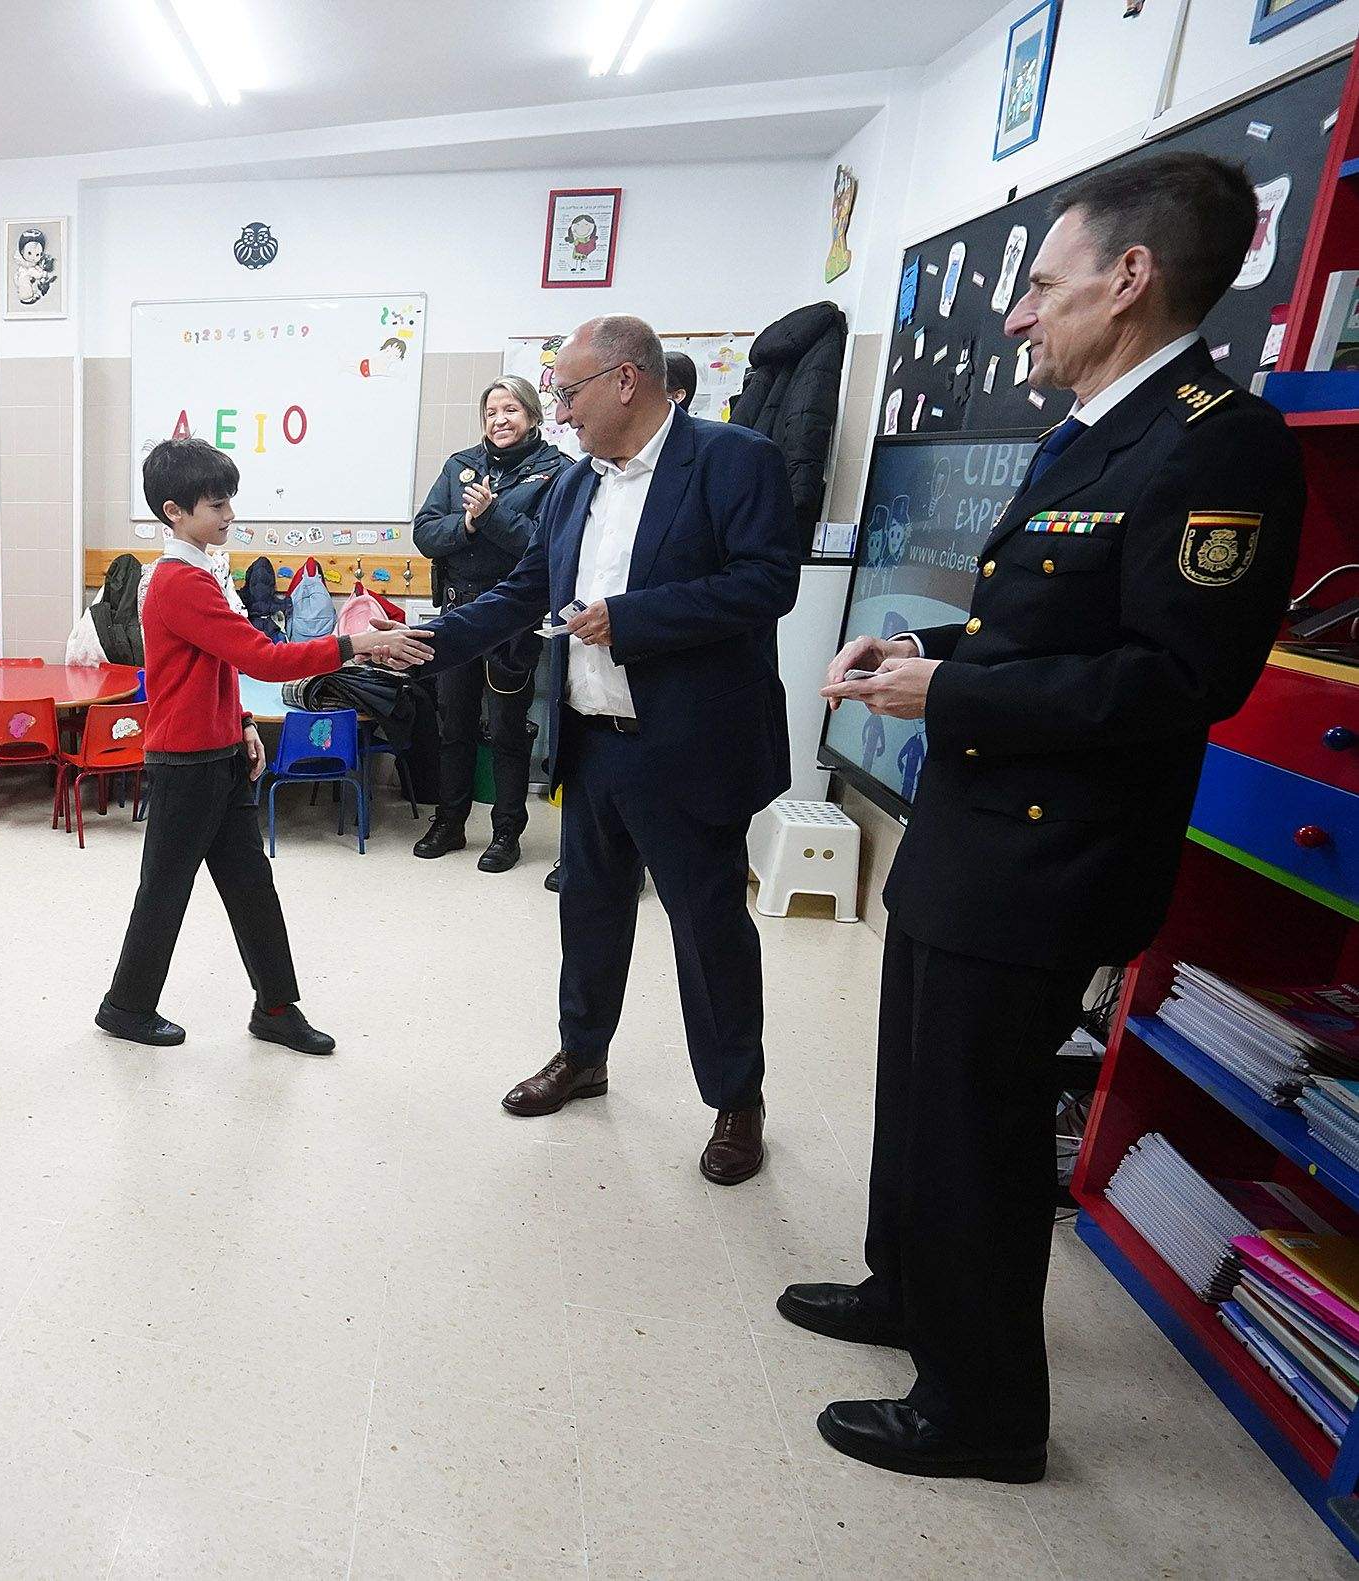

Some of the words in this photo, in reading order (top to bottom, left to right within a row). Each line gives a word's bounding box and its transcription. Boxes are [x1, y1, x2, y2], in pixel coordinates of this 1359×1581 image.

[184, 330, 192, 343] 0
[195, 332, 200, 343] 1
[202, 329, 211, 341] 2
[214, 329, 222, 341] 3
[227, 328, 236, 339] 4
[243, 330, 251, 341] 5
[257, 328, 265, 339] 6
[271, 326, 279, 338] 7
[287, 325, 295, 336] 8
[301, 326, 309, 337] 9
[172, 409, 191, 440] A
[216, 409, 238, 450] E
[254, 413, 267, 453] I
[283, 405, 307, 444] O
[909, 541, 979, 574] www.cibere
